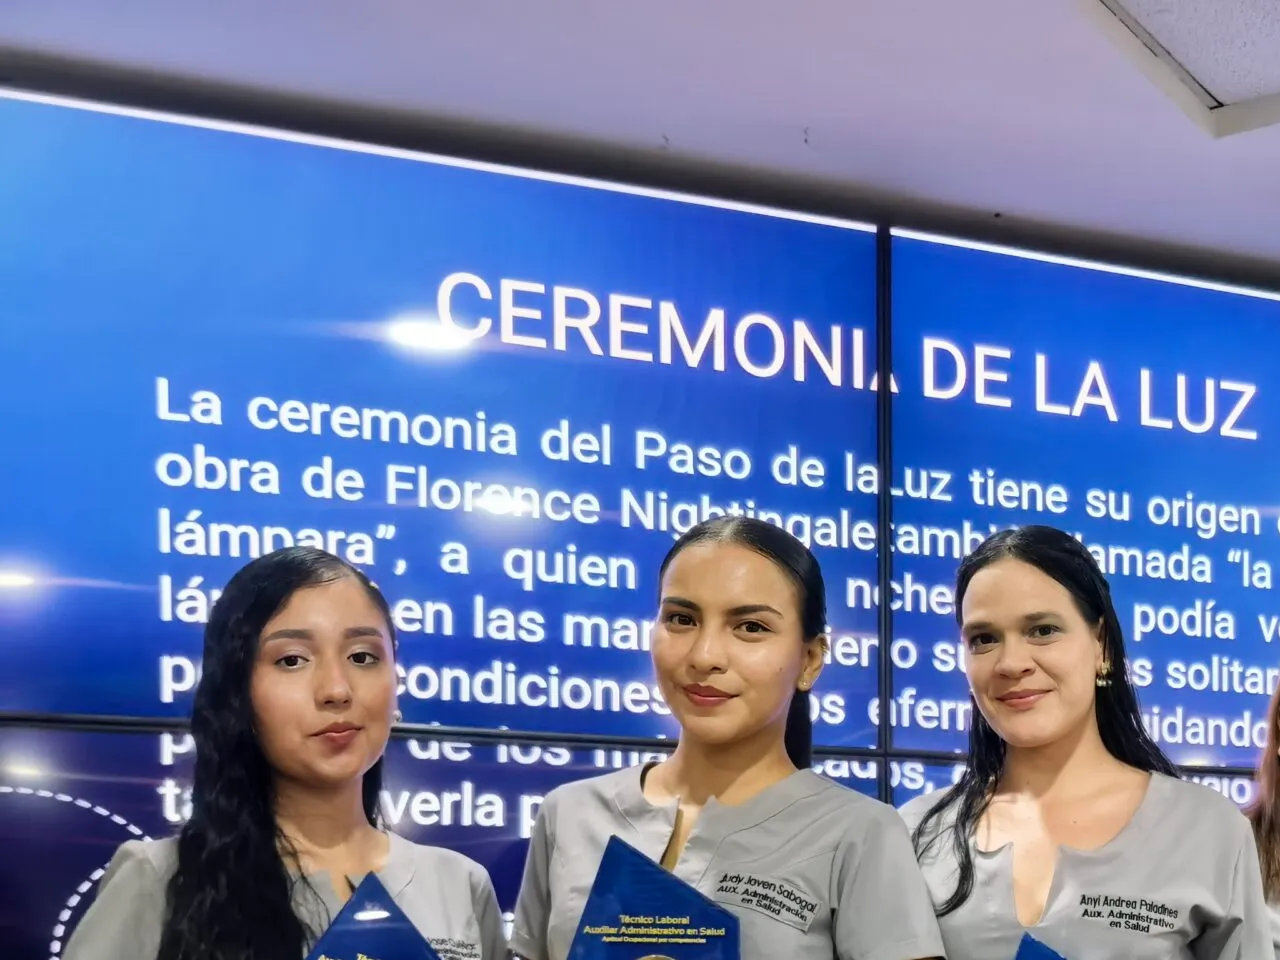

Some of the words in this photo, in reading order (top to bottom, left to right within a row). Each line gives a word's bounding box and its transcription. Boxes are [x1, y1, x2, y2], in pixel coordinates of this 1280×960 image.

[923, 337, 1012, 407] DE
[1035, 352, 1118, 421] LA
[1140, 367, 1257, 440] LUZ
[156, 377, 222, 425] La
[248, 396, 518, 455] ceremonia
[540, 419, 611, 466] del
[635, 430, 751, 479] Paso
[772, 445, 825, 487] de
[846, 452, 878, 494] la
[968, 468, 1068, 513] tiene
[1086, 488, 1130, 521] su
[1147, 493, 1260, 539] origen
[155, 443, 280, 495] obra
[302, 456, 365, 501] de
[386, 464, 600, 524] Florence
[1074, 532, 1212, 583] amada
[1227, 549, 1272, 590] “la
[440, 541, 470, 575] a
[503, 543, 637, 591] quien
[1133, 599, 1235, 642] podía
[393, 598, 453, 637] en
[473, 595, 546, 644] las
[380, 780, 505, 827] verla
[740, 897, 753, 906] en
[755, 899, 781, 916] Salud
[741, 888, 808, 922] Administración
[744, 876, 776, 892] Joven
[777, 884, 818, 913] Sabogal
[1102, 896, 1137, 910] Andrea
[583, 925, 618, 934] Auxiliar
[620, 926, 685, 935] Administrativo
[699, 927, 726, 936] Salud
[619, 915, 654, 924] Técnico
[655, 916, 690, 925] Laboral
[1107, 910, 1174, 930] Administrativo
[1109, 920, 1122, 929] en
[1124, 920, 1150, 934] Salud
